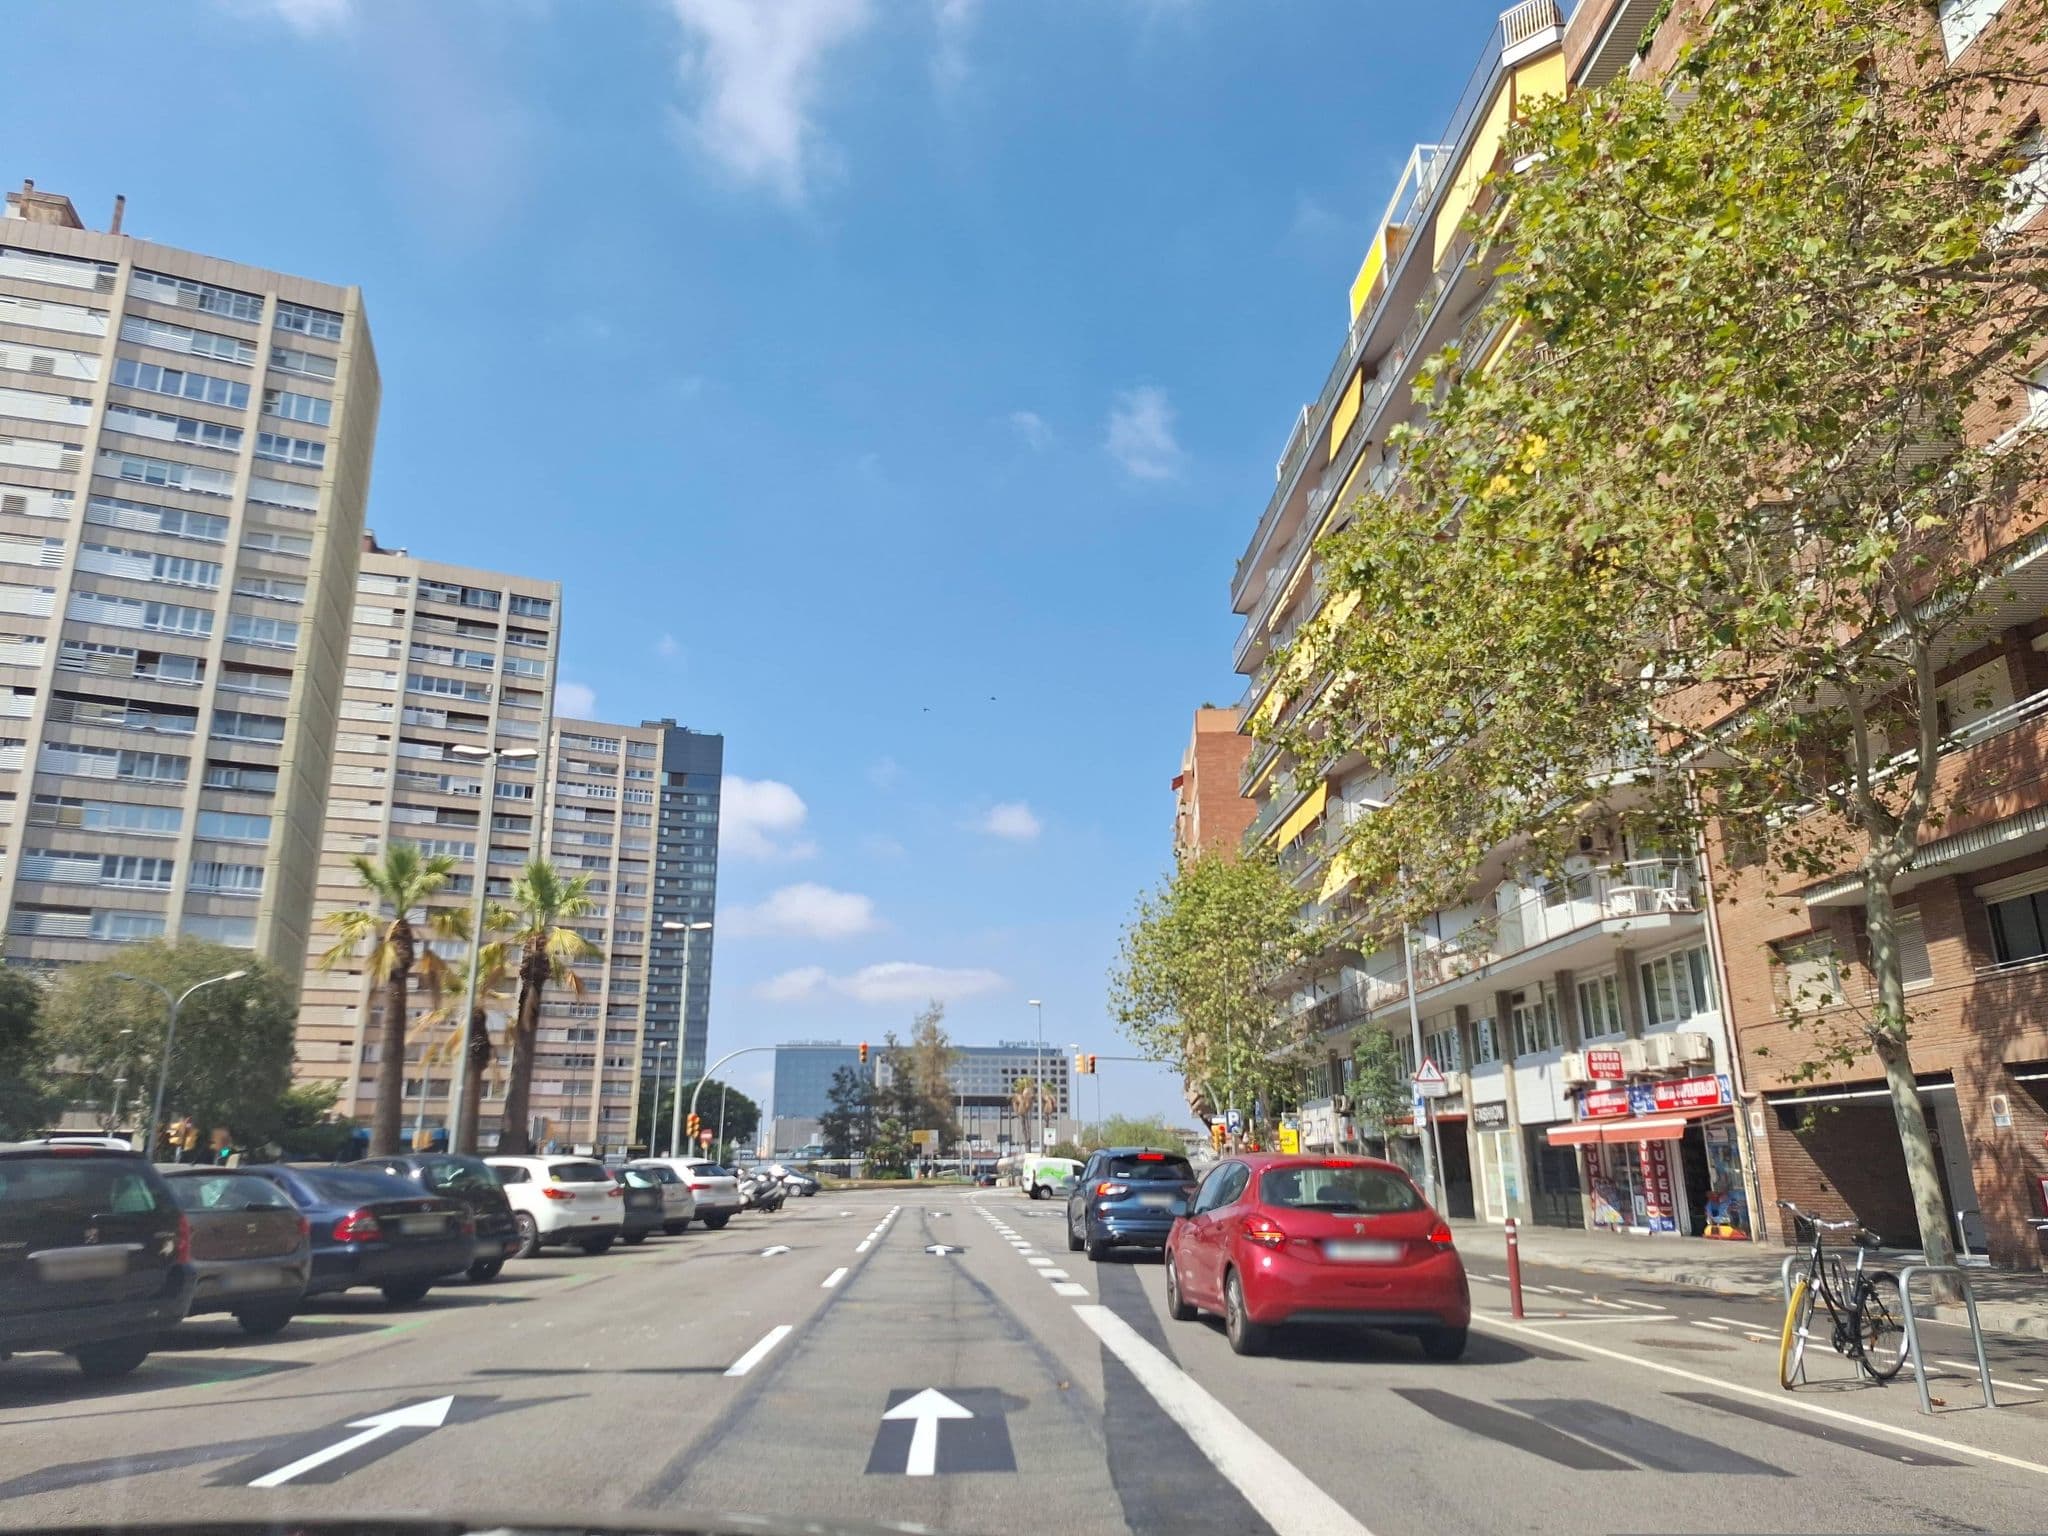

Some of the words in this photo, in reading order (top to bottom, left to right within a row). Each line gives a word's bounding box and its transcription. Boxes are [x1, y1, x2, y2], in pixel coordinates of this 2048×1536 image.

[1591, 1051, 1620, 1062] SUPER
[1640, 1140, 1655, 1204] SUPER
[1653, 1140, 1671, 1204] SUPER
